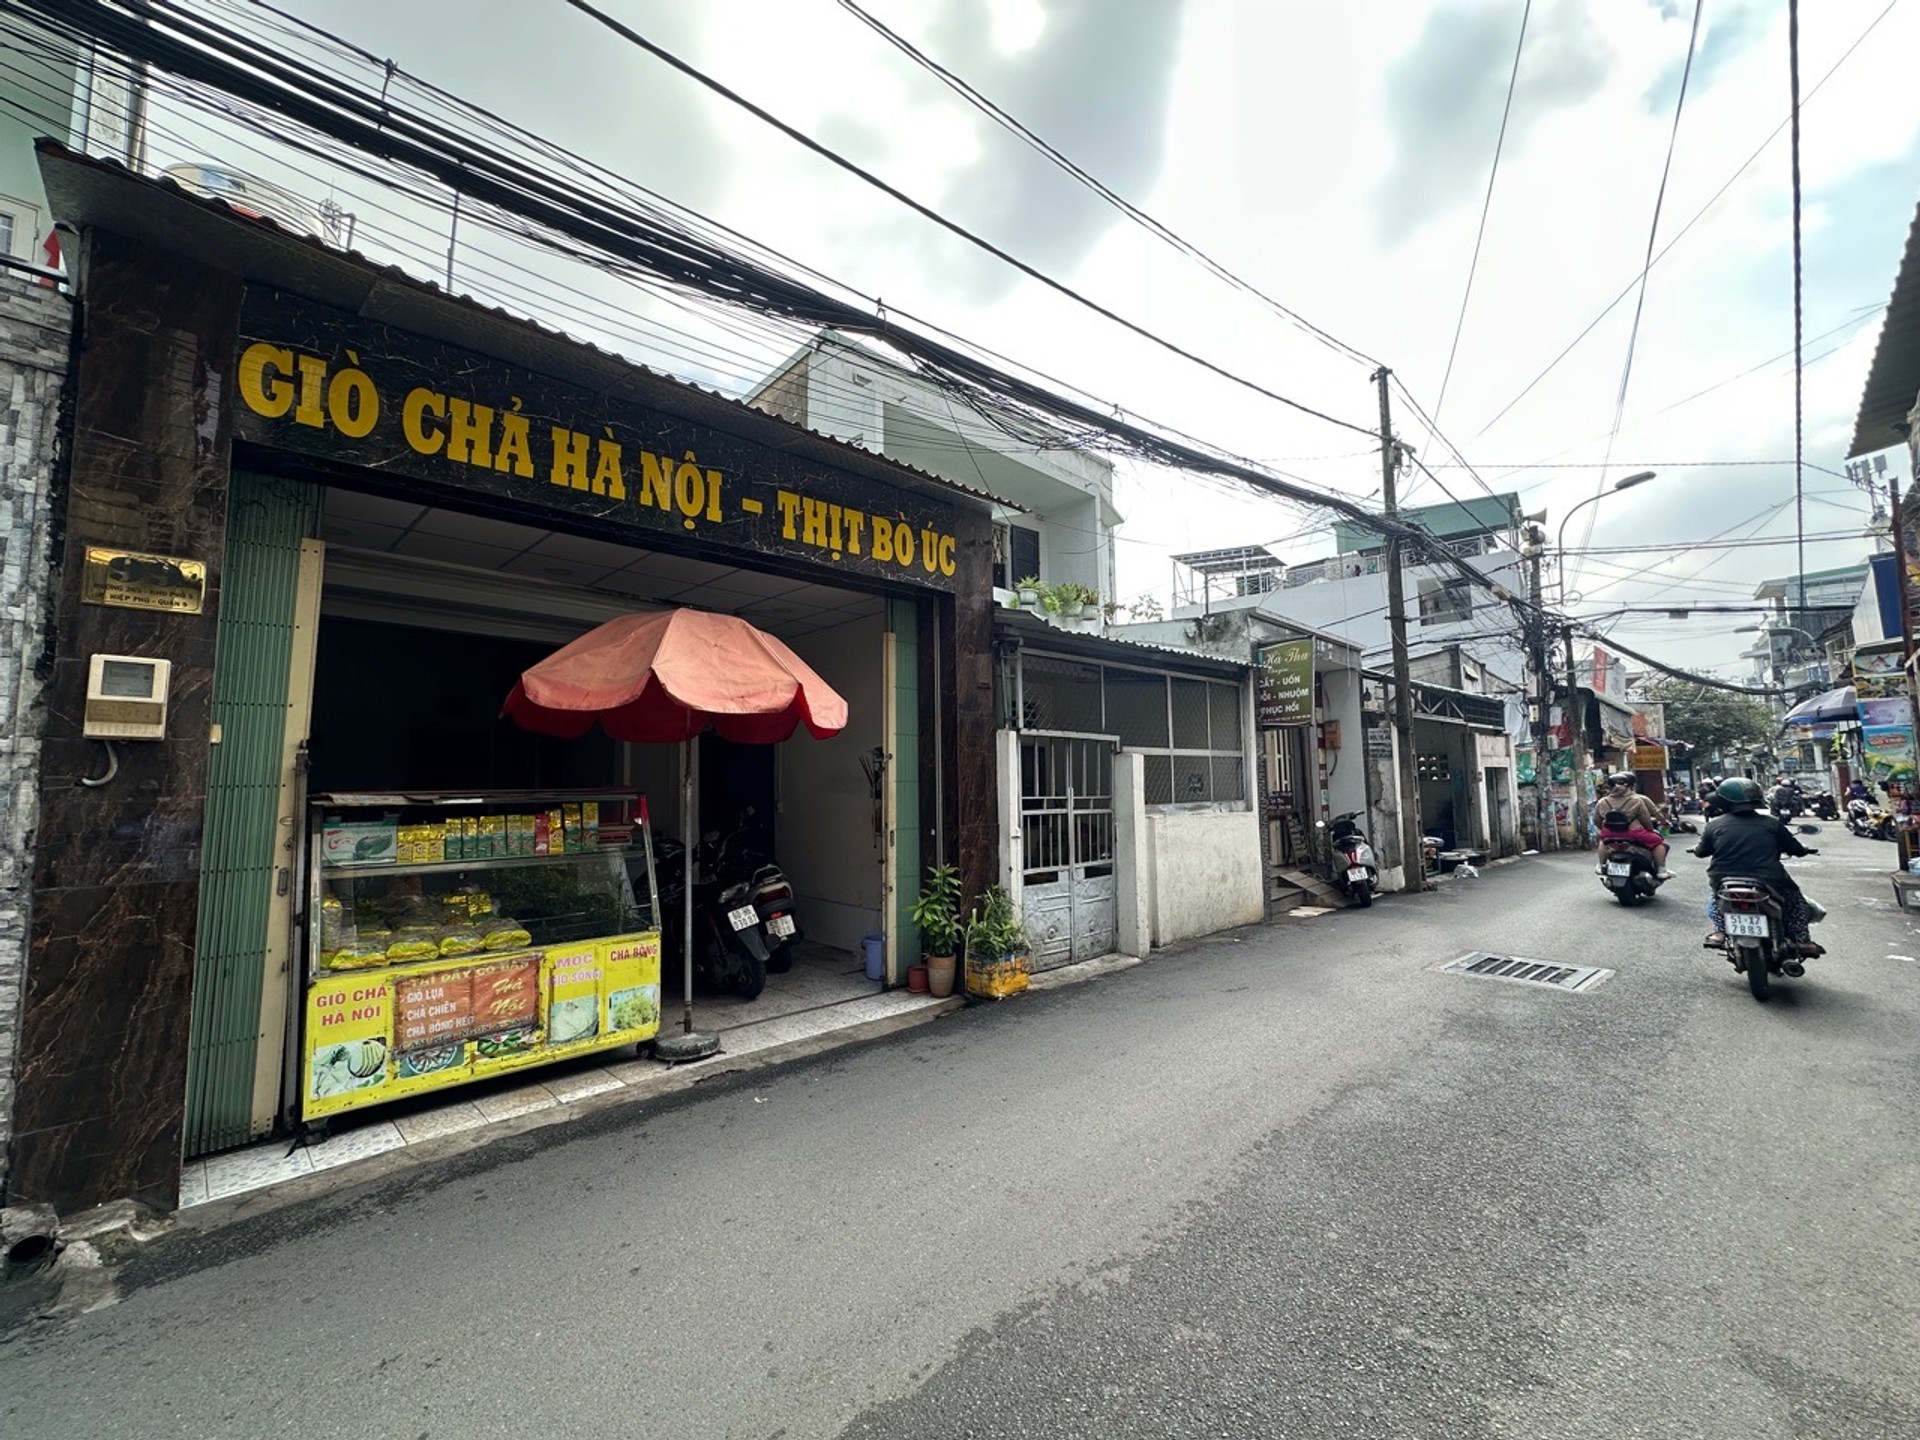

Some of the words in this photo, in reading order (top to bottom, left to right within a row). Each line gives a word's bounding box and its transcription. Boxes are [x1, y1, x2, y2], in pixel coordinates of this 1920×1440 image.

[238, 342, 379, 438] GIÒ
[402, 387, 534, 478] CHẢ
[550, 426, 625, 500] HÀ
[640, 450, 723, 530] NỘI
[777, 490, 864, 561] THỊT
[872, 511, 914, 566] BÒ
[921, 521, 955, 577] ÚC
[316, 989, 346, 1008] GIÒ
[322, 1009, 345, 1026] HÀ
[352, 1005, 380, 1021] NỘI
